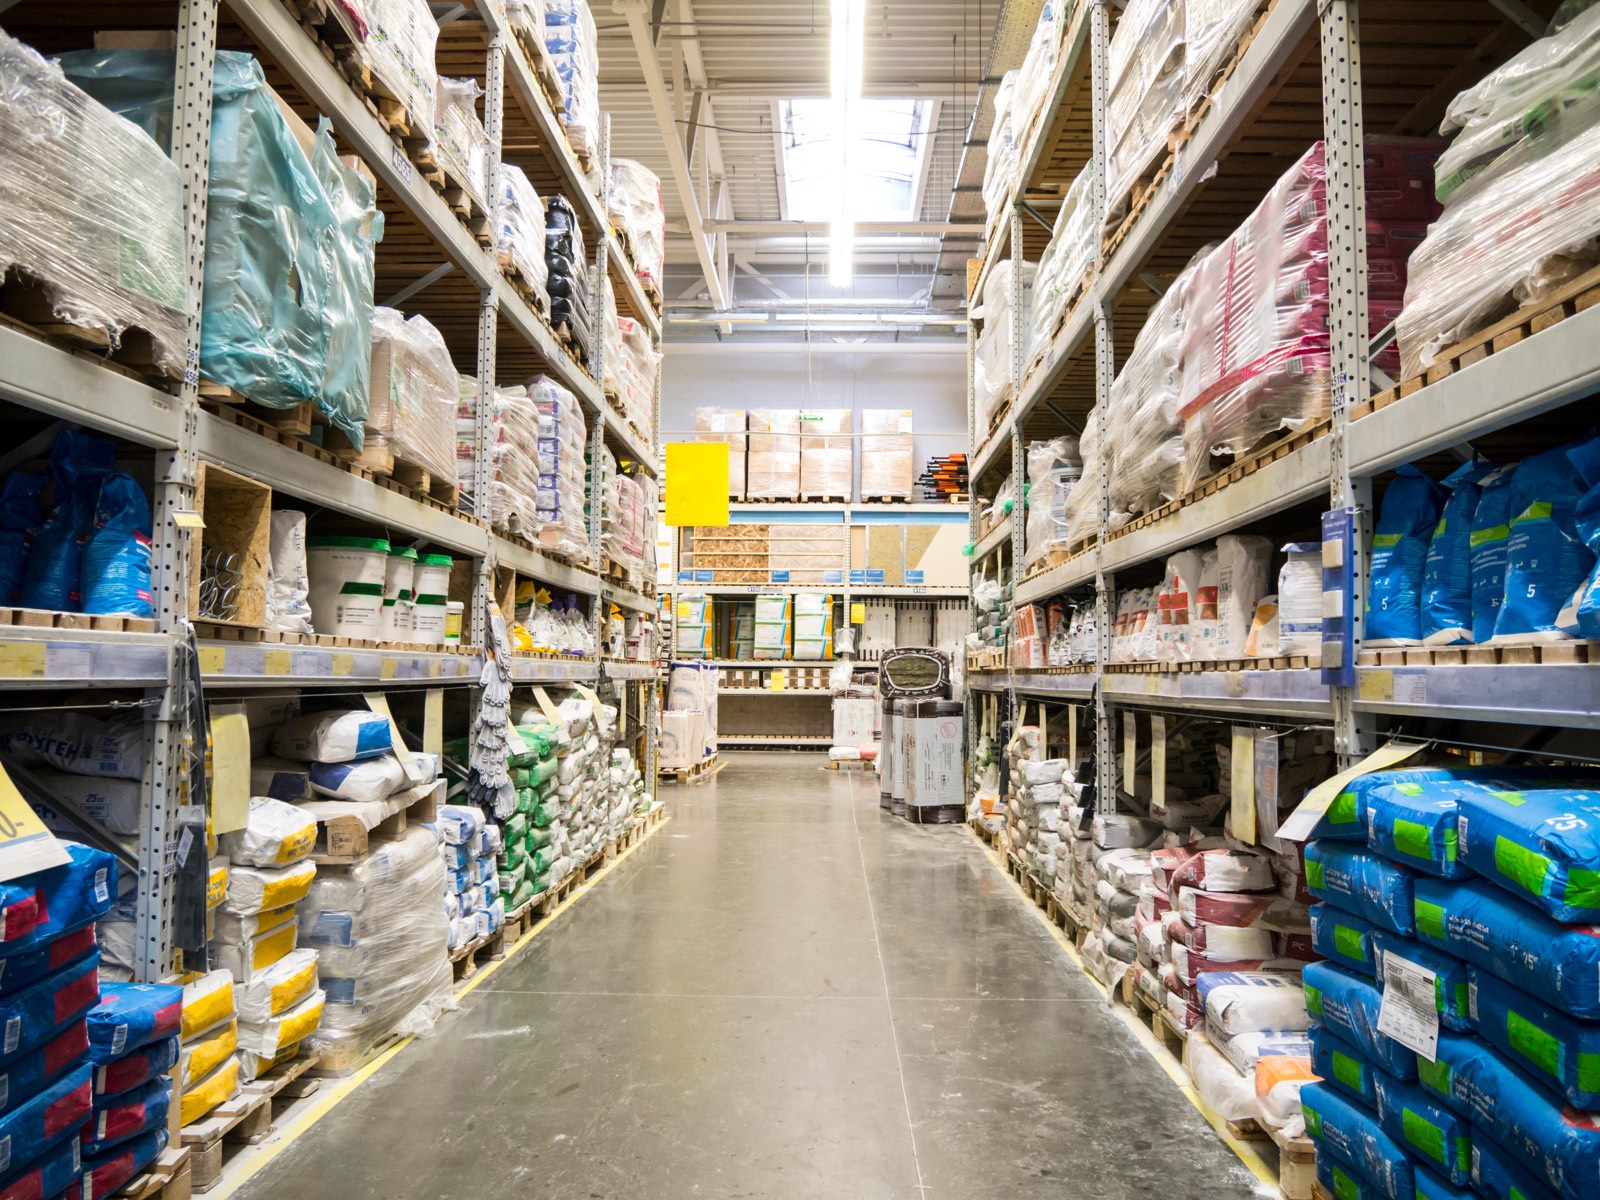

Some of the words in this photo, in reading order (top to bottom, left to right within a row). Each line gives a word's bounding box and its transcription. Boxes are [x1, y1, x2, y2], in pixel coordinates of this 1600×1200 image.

[1527, 584, 1536, 598] 5
[86, 794, 97, 803] 25
[1545, 813, 1588, 831] 25
